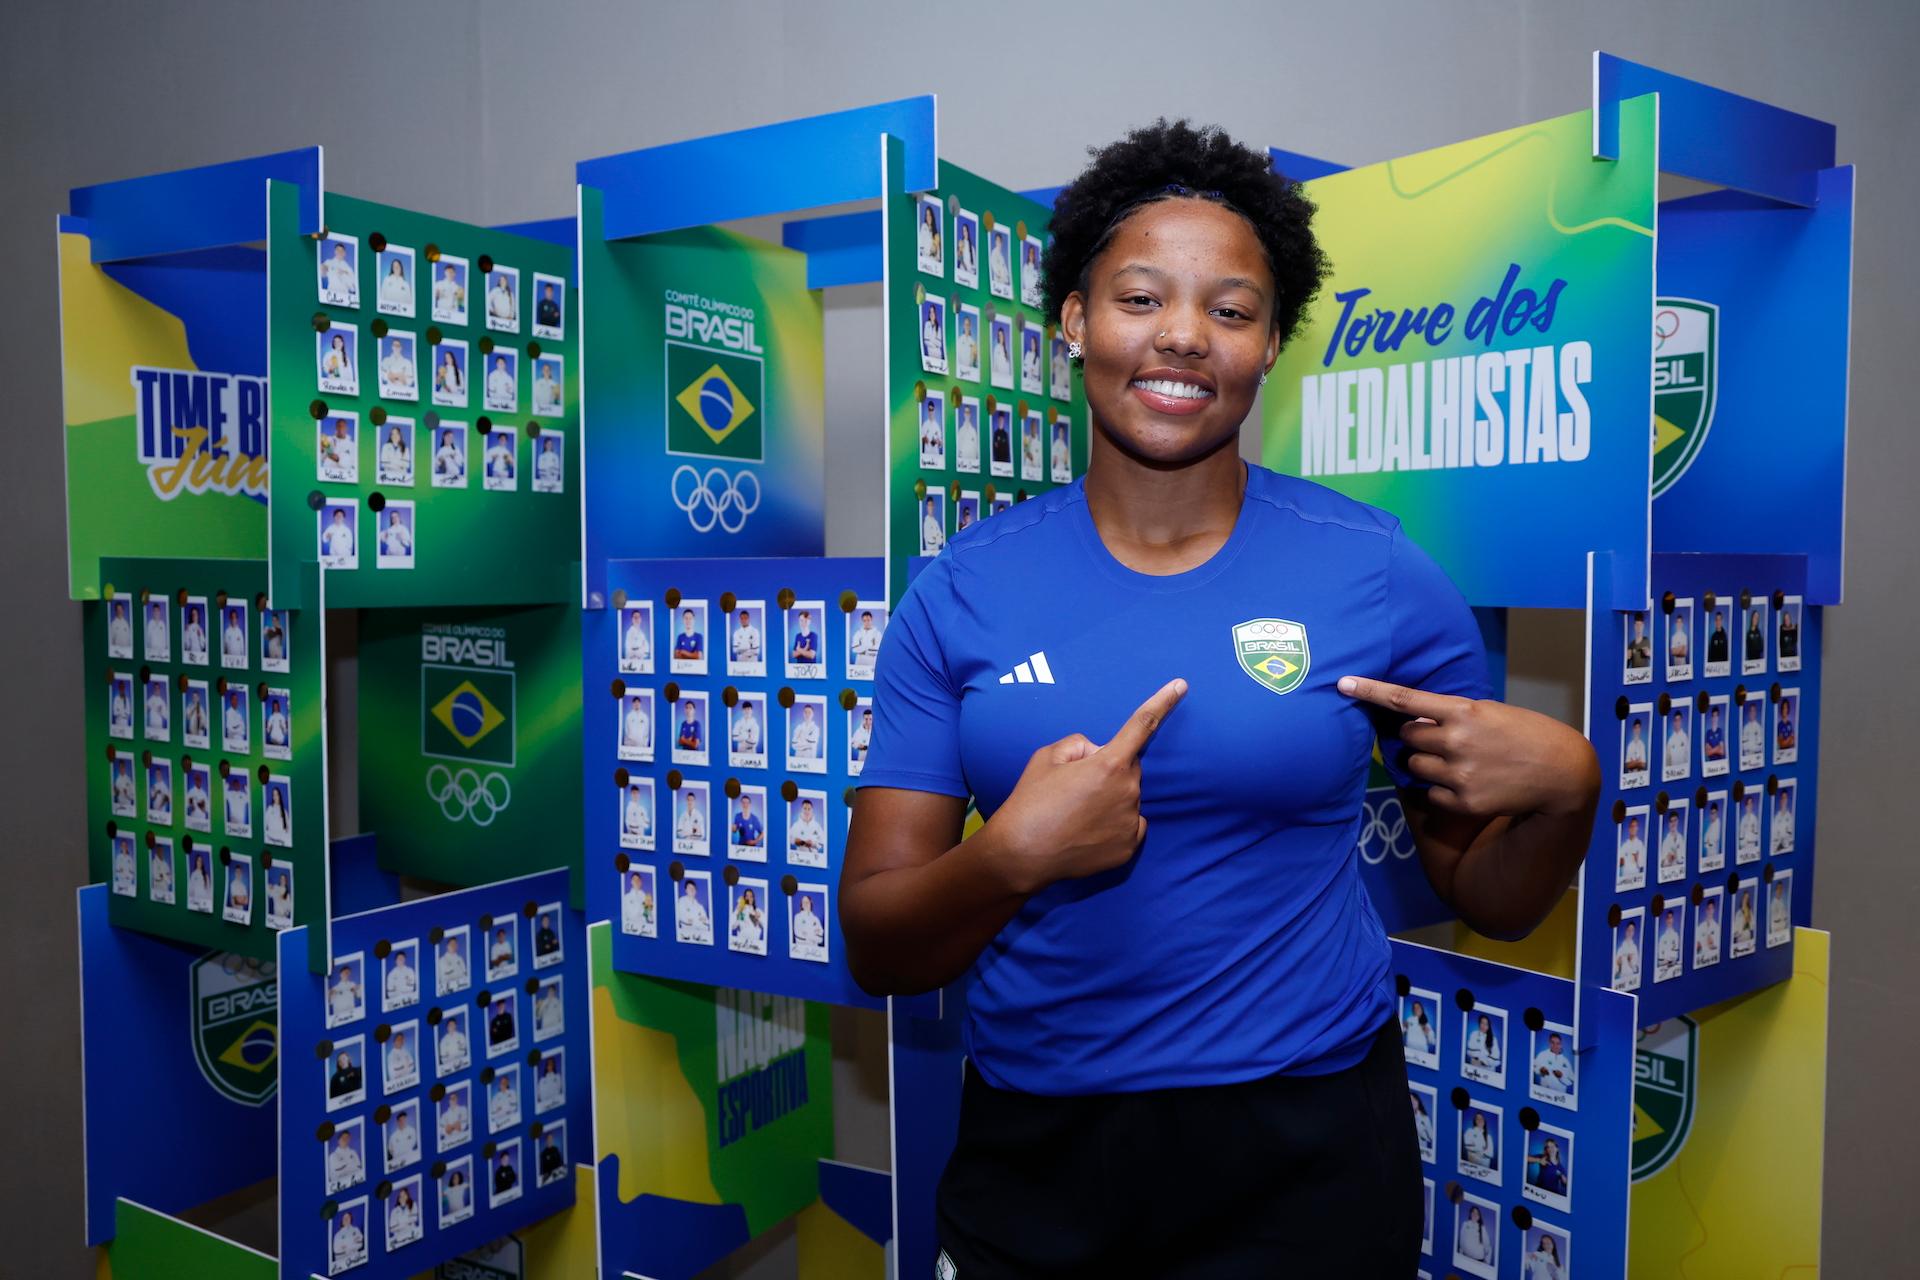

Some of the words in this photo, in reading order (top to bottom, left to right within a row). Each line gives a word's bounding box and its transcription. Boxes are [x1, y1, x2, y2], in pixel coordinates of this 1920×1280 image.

[665, 289, 699, 307] COMITÊ
[1322, 288, 1455, 367] Torre
[1464, 263, 1568, 346] dos
[665, 303, 763, 354] BRASIL
[136, 370, 229, 460] TIME
[238, 379, 268, 463] B
[1300, 340, 1592, 476] MEDALHISTAS
[152, 425, 268, 494] Jún
[422, 634, 515, 668] BRASIL
[1244, 641, 1300, 652] BRASIL
